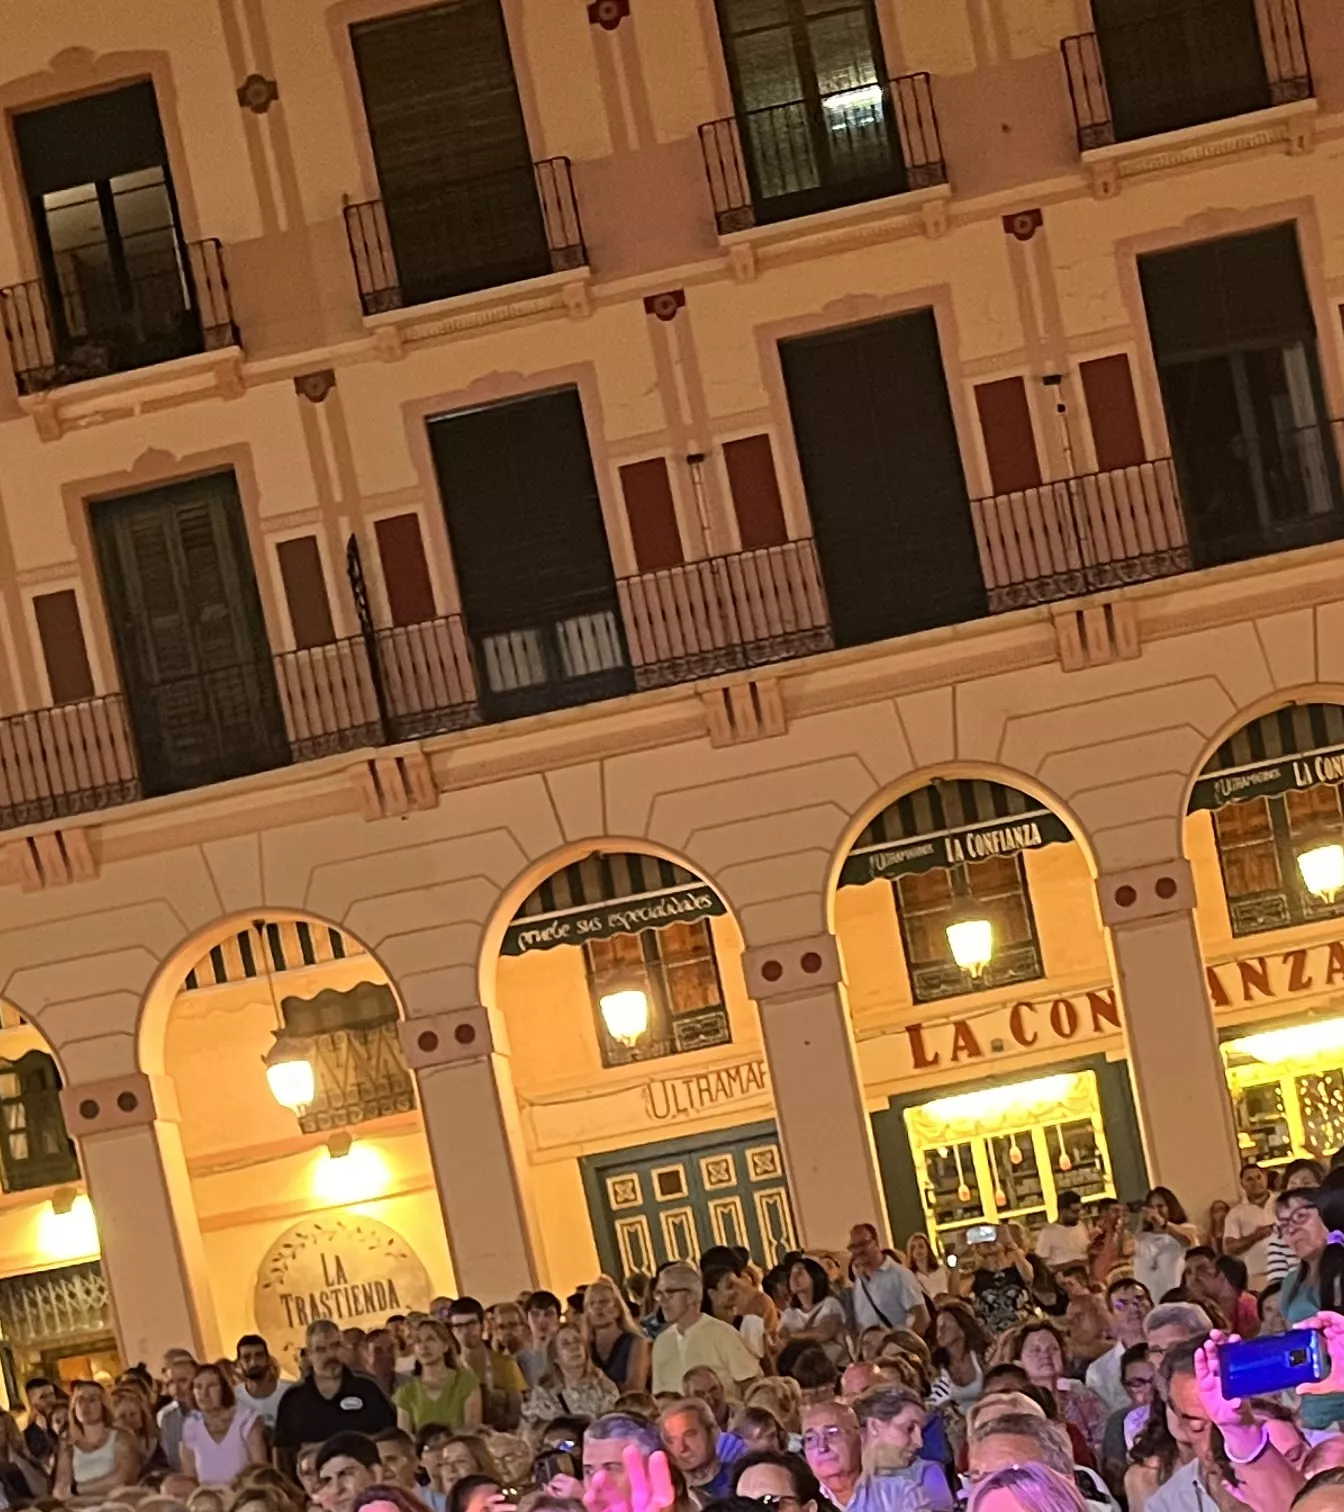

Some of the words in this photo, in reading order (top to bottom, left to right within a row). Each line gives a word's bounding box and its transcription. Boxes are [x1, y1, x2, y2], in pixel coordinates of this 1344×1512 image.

[1293, 761, 1313, 787] LA
[944, 838, 965, 863] LA
[966, 823, 1043, 858] CONFIANZA
[576, 917, 603, 934] sus
[319, 1252, 349, 1288] LA
[279, 1279, 401, 1329] TRASTIENDA
